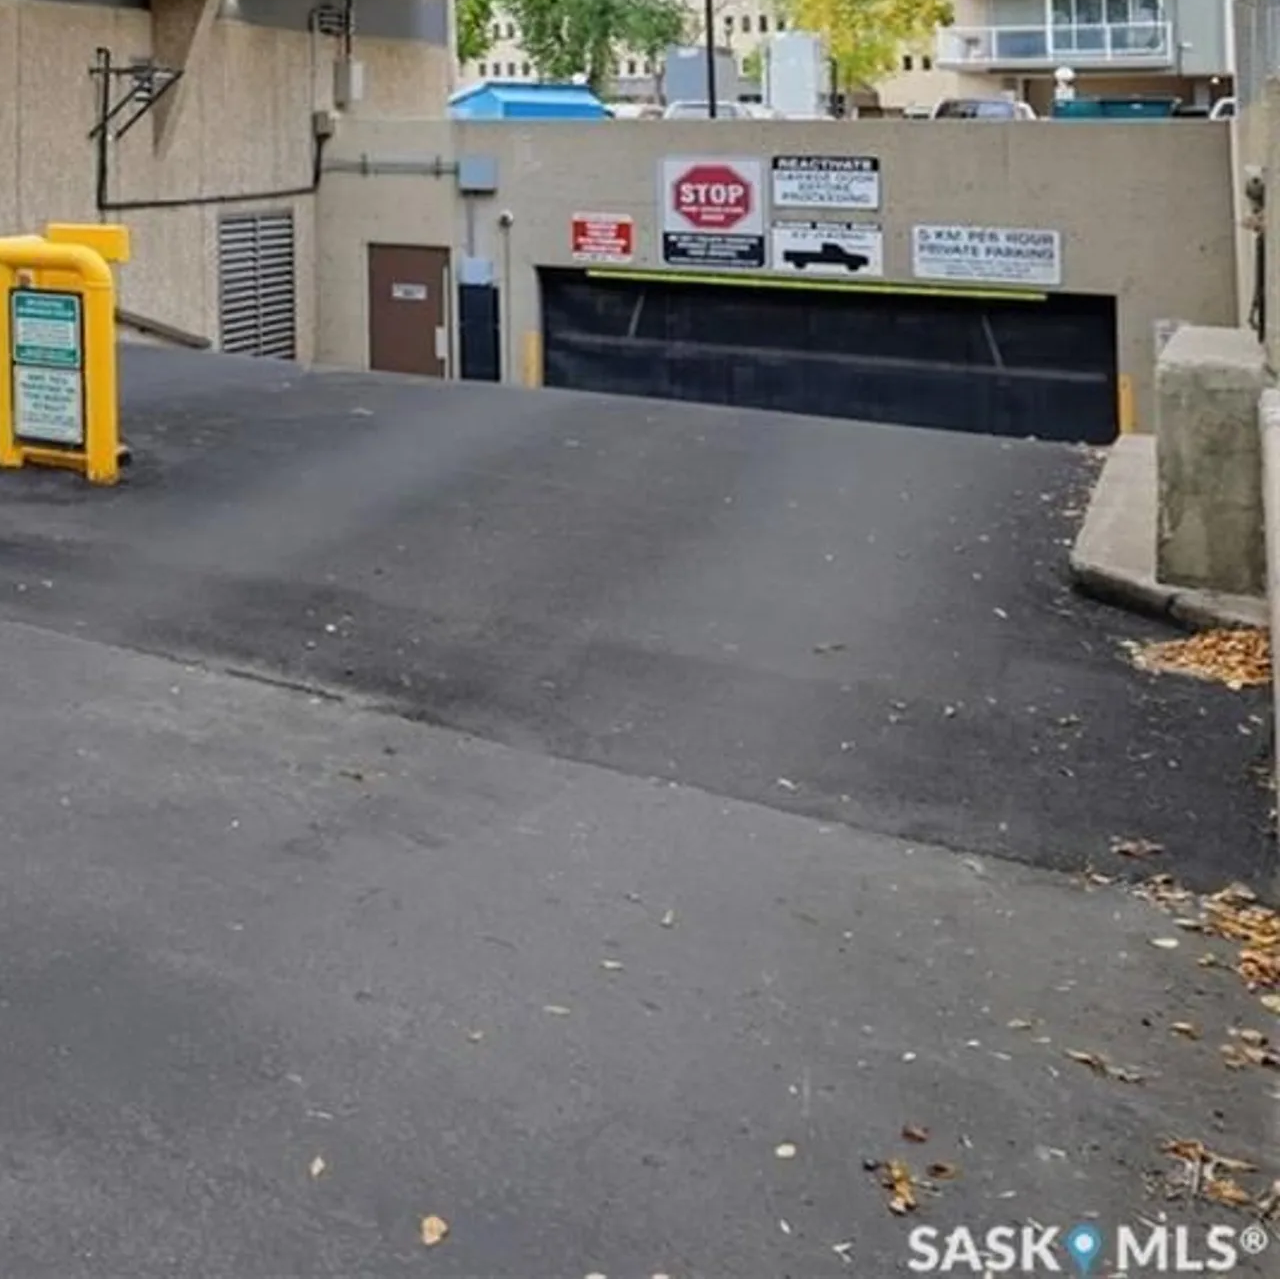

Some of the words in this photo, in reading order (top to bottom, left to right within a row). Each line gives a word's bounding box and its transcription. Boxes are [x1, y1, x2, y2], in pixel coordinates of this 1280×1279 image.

[779, 159, 872, 171] REACTIVATE
[679, 183, 744, 205] STOP
[967, 231, 1000, 243] PER
[1005, 232, 1054, 246] HOUR
[918, 242, 978, 257] PRIVATE
[983, 245, 1055, 260] PARKING
